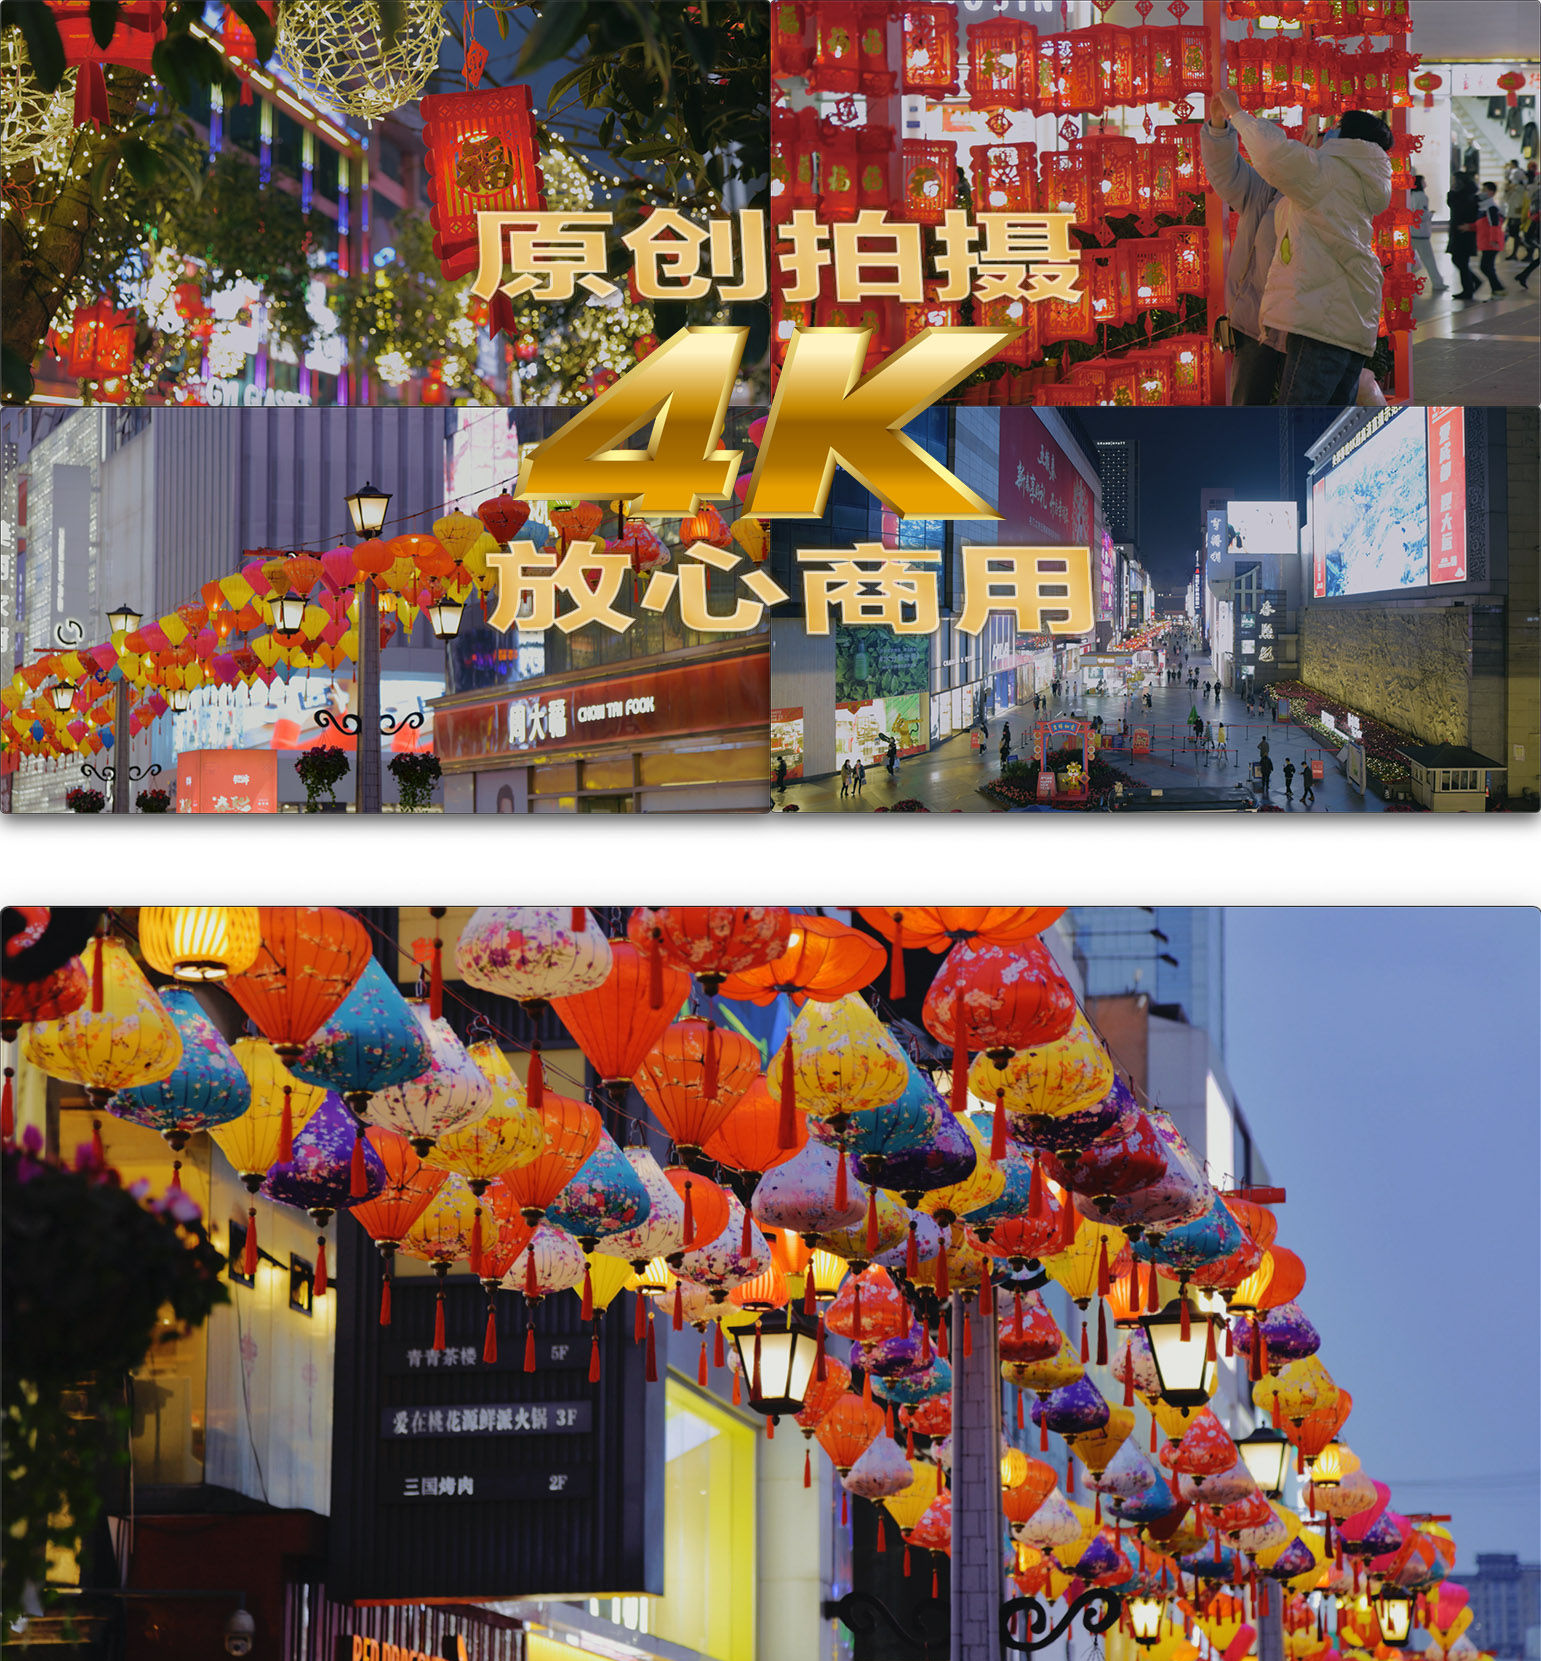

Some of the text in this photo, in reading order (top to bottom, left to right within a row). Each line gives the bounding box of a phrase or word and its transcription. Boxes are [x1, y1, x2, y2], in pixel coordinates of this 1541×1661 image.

[509, 698, 567, 744] 周大福
[577, 696, 655, 723] CHOW TAI FOOK
[407, 1345, 570, 1368] 青青茶楼 5F
[392, 1406, 578, 1436] 爱在桃花源鲜派火锅 3F
[403, 1475, 568, 1497] 三国烤肉 2F
